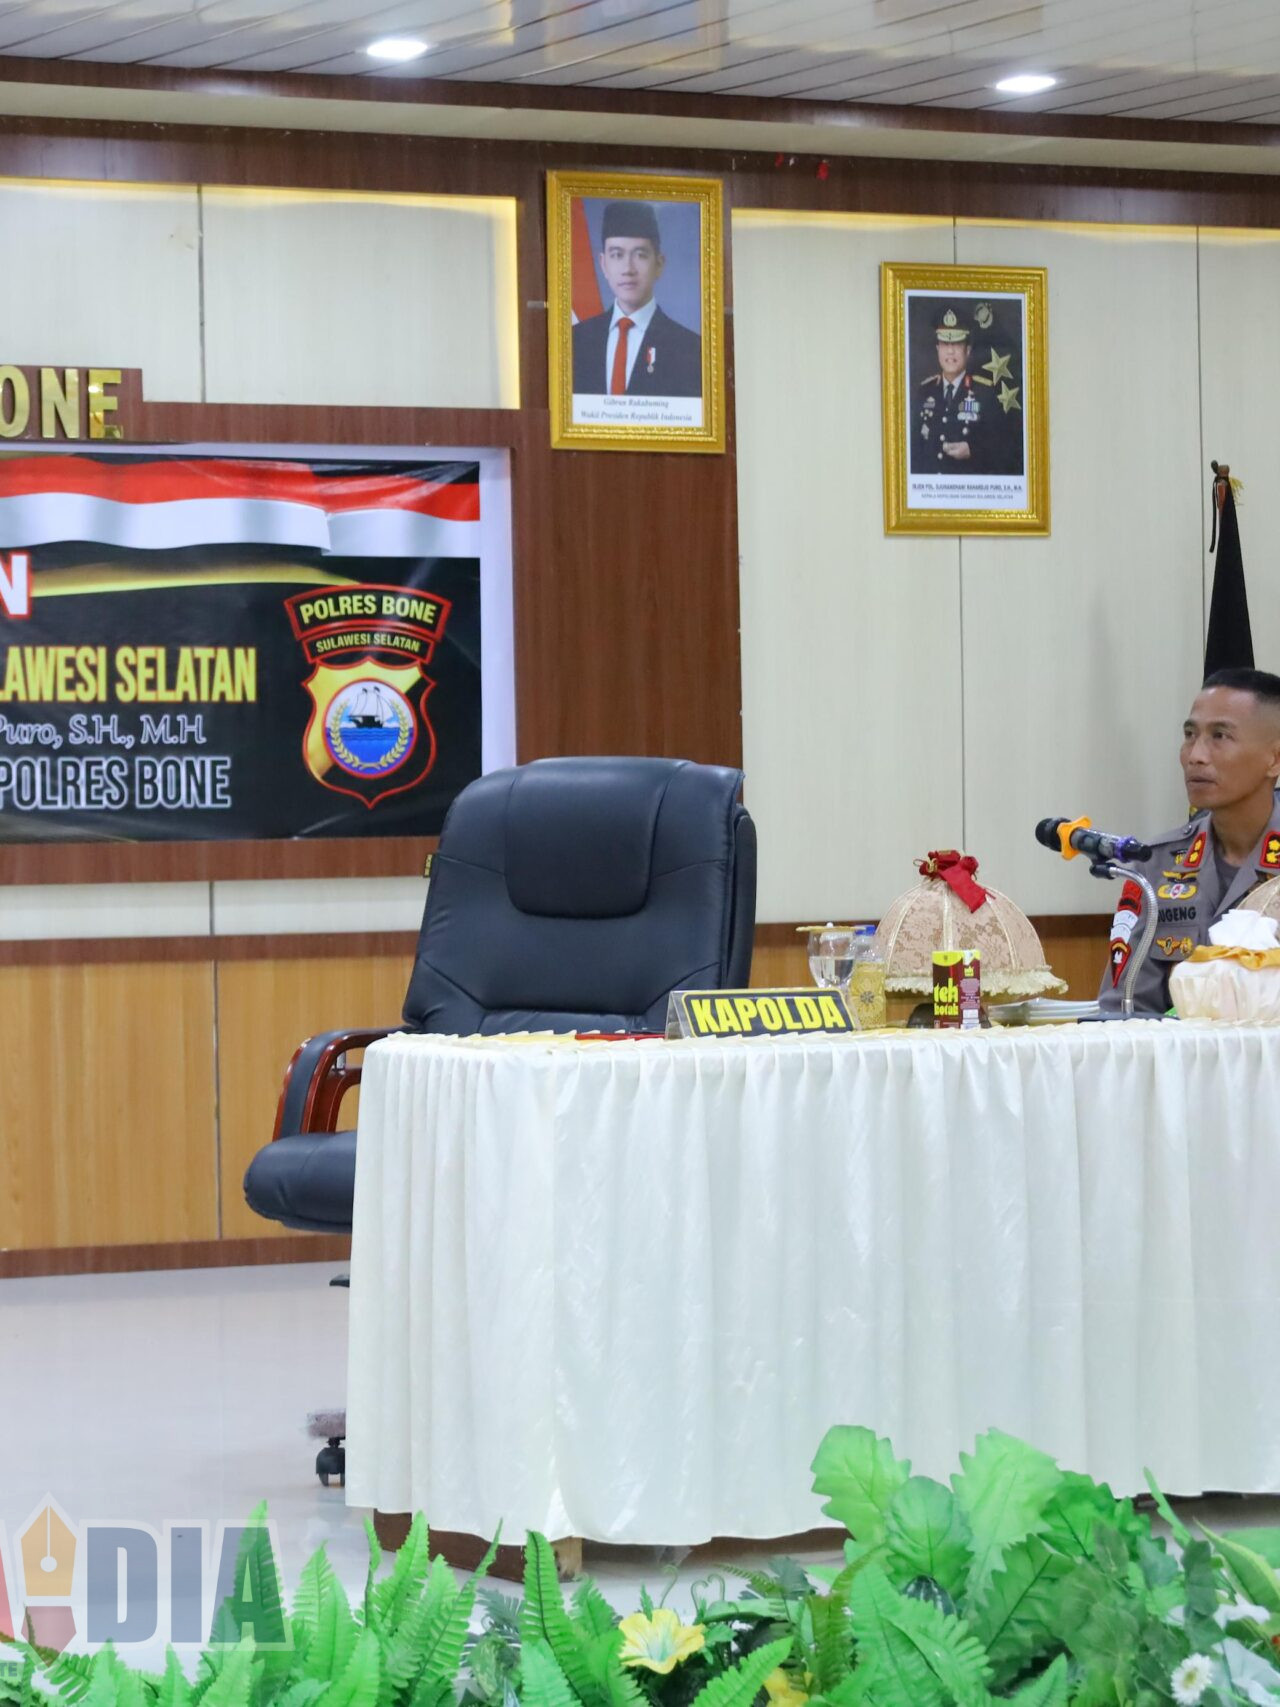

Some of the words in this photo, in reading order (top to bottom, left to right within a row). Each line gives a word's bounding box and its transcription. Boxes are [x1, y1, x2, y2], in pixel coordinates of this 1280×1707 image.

[299, 594, 377, 625] POLRES
[381, 595, 438, 625] BONE
[316, 634, 371, 653] SULAWESI
[373, 633, 421, 653] SELATAN
[115, 646, 257, 703] SELATAN
[134, 755, 232, 810] BONE
[1158, 906, 1197, 923] UGENG
[933, 977, 959, 1003] teh
[690, 995, 847, 1034] KAPOLDA
